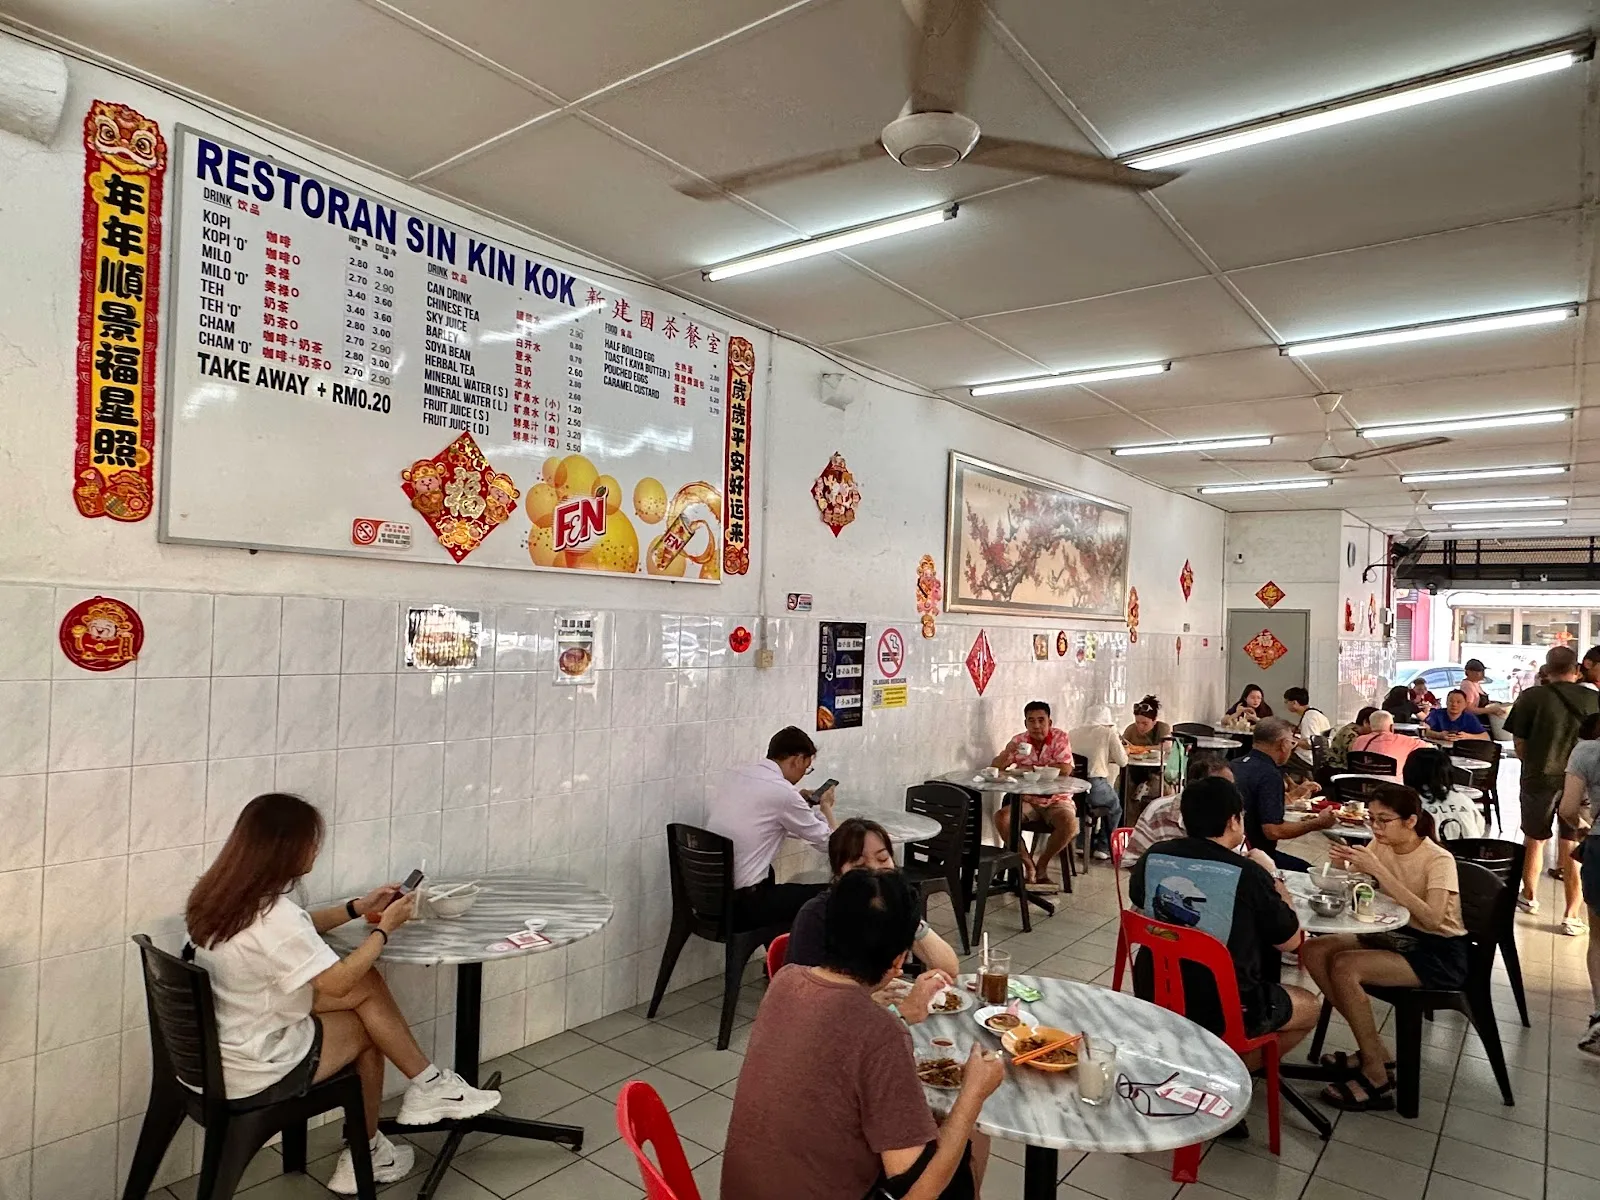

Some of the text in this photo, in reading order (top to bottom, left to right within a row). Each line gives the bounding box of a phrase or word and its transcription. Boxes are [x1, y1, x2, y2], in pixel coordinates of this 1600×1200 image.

[203, 187, 232, 208] DRINK
[196, 138, 577, 308] RESTORAN SIN KIN KOK
[202, 209, 231, 230] KOPI
[202, 226, 230, 247] KOPI
[265, 230, 292, 248] 咖啡
[201, 243, 232, 265] MILO
[201, 261, 231, 282] MILO
[349, 257, 368, 270] 2.80
[376, 266, 394, 278] 3.00
[427, 263, 448, 279] DRINK
[200, 278, 224, 297] TEH
[348, 273, 394, 294] 2.70 2.90
[427, 281, 472, 306] CAN DRINK
[200, 295, 223, 314] TEH
[263, 296, 289, 314] 奶茶
[347, 289, 393, 308] 3.40 3.60
[426, 295, 480, 323] CHINESE TEA
[94, 173, 145, 468] 年年順景福星照
[199, 313, 235, 335] CHAM
[346, 304, 392, 323] 3.40 3.60
[426, 311, 468, 333] SKY JUICE
[584, 286, 722, 356] 新建國茶餐室
[346, 319, 391, 339] 2.80 3.00
[426, 324, 458, 344] BARLEY
[604, 322, 618, 336] FOOD
[198, 331, 234, 352] CHAM
[345, 334, 391, 355] 2.70 2.90
[425, 339, 471, 362] SOYA BEAN
[604, 338, 655, 363] HALF BOILED EGG
[344, 350, 390, 369] 2.80 3.00
[424, 353, 476, 377] HERBAL TEA
[604, 350, 624, 366] TOAST
[197, 351, 392, 414] TAKE AWAY + RM0.20
[343, 365, 391, 386] 2.70 2.90
[424, 367, 461, 388] MINERAL
[463, 377, 491, 395] WATER
[568, 366, 583, 378] 2.60
[603, 363, 649, 385] POUCHED EGGS
[424, 382, 461, 403] MINERAL
[463, 391, 491, 409] WATER
[603, 375, 660, 400] CARAMEL CUSTARD
[423, 397, 447, 414] FRUIT
[448, 403, 472, 418] JUICE
[568, 404, 582, 414] 1.20
[423, 412, 447, 428] FRUIT
[448, 418, 471, 433] JUICE
[567, 417, 581, 428] 2.50
[567, 429, 581, 440] 3.20
[566, 442, 581, 453] 5.50
[555, 497, 606, 549] F&N
